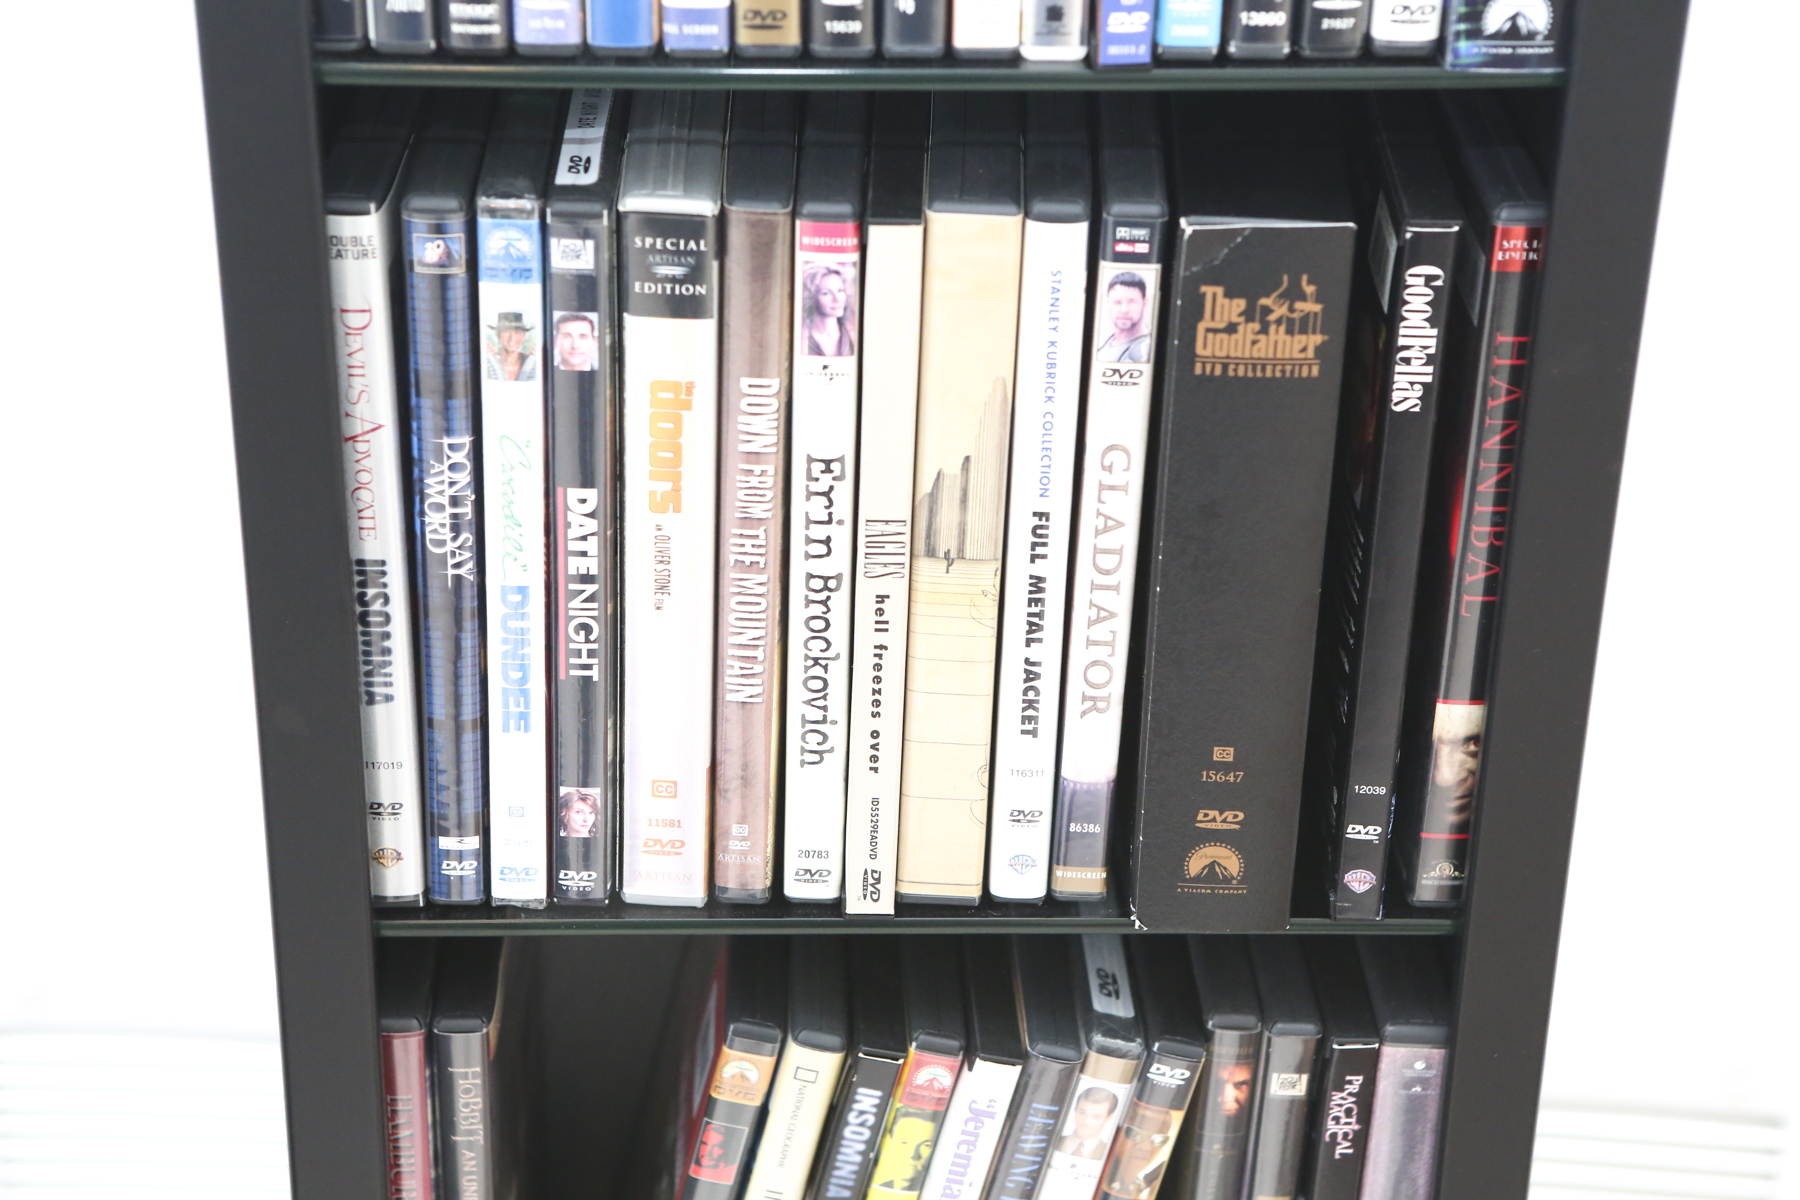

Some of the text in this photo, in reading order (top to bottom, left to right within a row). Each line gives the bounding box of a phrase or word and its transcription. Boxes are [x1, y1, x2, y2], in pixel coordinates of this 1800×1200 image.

[743, 9, 787, 22] DVD
[1391, 4, 1435, 15] DVD
[567, 155, 583, 174] DVD
[634, 236, 709, 251] SPECIAL
[801, 236, 859, 247] WIDESCREEN
[646, 254, 696, 265] ARTISAN
[634, 281, 707, 296] EDITION
[1199, 285, 1247, 322] The
[1195, 321, 1329, 359] Godfather
[1102, 368, 1144, 379] DVD
[1194, 362, 1320, 378] DVD COLLECTION
[1039, 270, 1062, 498] STANLEY KUBRICK COLLECTION
[649, 380, 693, 514] doors
[343, 410, 386, 541] ADVOCATE
[1461, 332, 1530, 617] HANNIBAL
[424, 460, 449, 554] A WORD
[725, 377, 780, 703] DOWN FROM THE MOUNTAIN
[654, 534, 671, 565] OLIVER
[864, 519, 907, 579] EAGLES
[449, 533, 474, 582] SAY
[566, 487, 600, 682] DATE NIGHT
[654, 568, 671, 597] STONE
[1080, 443, 1132, 719] GLADIATOR
[800, 454, 846, 768] Erin Brockovich
[354, 558, 395, 706] INSOMNIA
[1020, 511, 1051, 738] FULL METAL JACKET
[500, 585, 532, 733] DUNDEE
[868, 594, 891, 774] hell freezes over
[365, 761, 403, 771] 117019
[1010, 769, 1044, 778] 116311
[1200, 770, 1244, 783] 15647
[655, 784, 674, 795] CC
[1354, 785, 1386, 795] 12039
[369, 801, 404, 812] DVD
[1009, 809, 1043, 819] DVD
[647, 818, 682, 828] 11581
[1196, 809, 1245, 823] DVD
[869, 797, 880, 860] ID5529EADVD
[1069, 822, 1101, 833] 86386
[1346, 824, 1383, 835] DVD
[643, 838, 686, 850] DVD
[717, 853, 760, 863] ARTISAN
[797, 849, 829, 859] 20783
[441, 860, 478, 870] DVD
[499, 866, 539, 877] DVD
[794, 868, 832, 878] DVD
[558, 870, 597, 882] DVD
[636, 871, 693, 882] ARTISAN
[1055, 869, 1107, 880] WIDESCREEN
[868, 868, 882, 903] DVD
[1096, 967, 1112, 998] DVD
[1149, 1063, 1191, 1079] DVD
[447, 1067, 484, 1145] HOBBIT
[1325, 1091, 1345, 1142] MAGIC
[1334, 1075, 1363, 1159] PRACTICAL
[826, 1087, 884, 1199] INSOMNIA
[461, 1149, 477, 1171] AN
